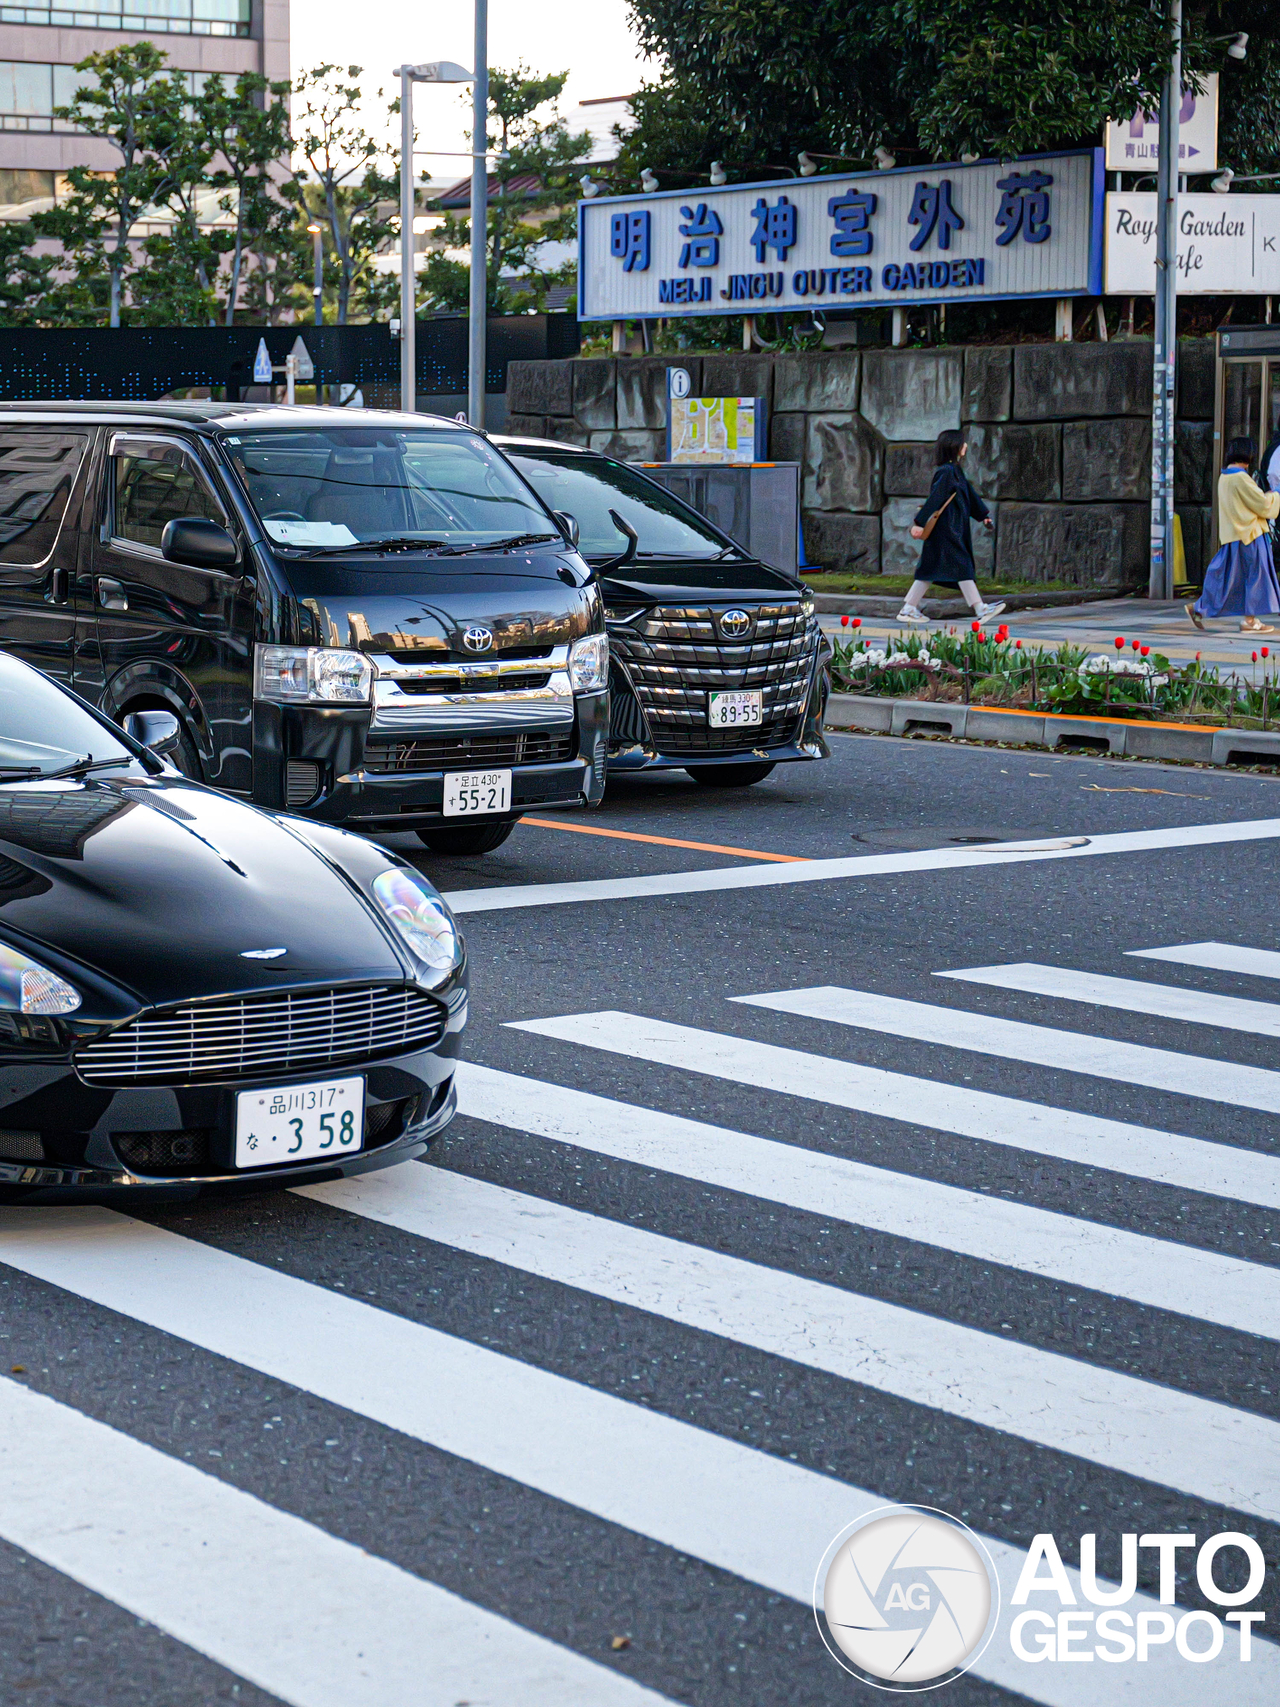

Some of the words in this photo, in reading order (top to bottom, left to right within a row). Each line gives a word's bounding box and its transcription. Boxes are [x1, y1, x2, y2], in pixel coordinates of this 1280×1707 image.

[1125, 143, 1186, 159] 青山駐場
[611, 169, 1054, 272] 明治神宮外苑
[1180, 209, 1246, 238] Garden
[1175, 244, 1203, 278] afe
[659, 276, 713, 304] MEIJI
[720, 271, 784, 300] JINGU
[792, 265, 873, 297] OUTER
[880, 257, 985, 293] GARDEN
[720, 705, 759, 723] 89-55
[459, 787, 505, 811] 55-21
[246, 1132, 259, 1151] な
